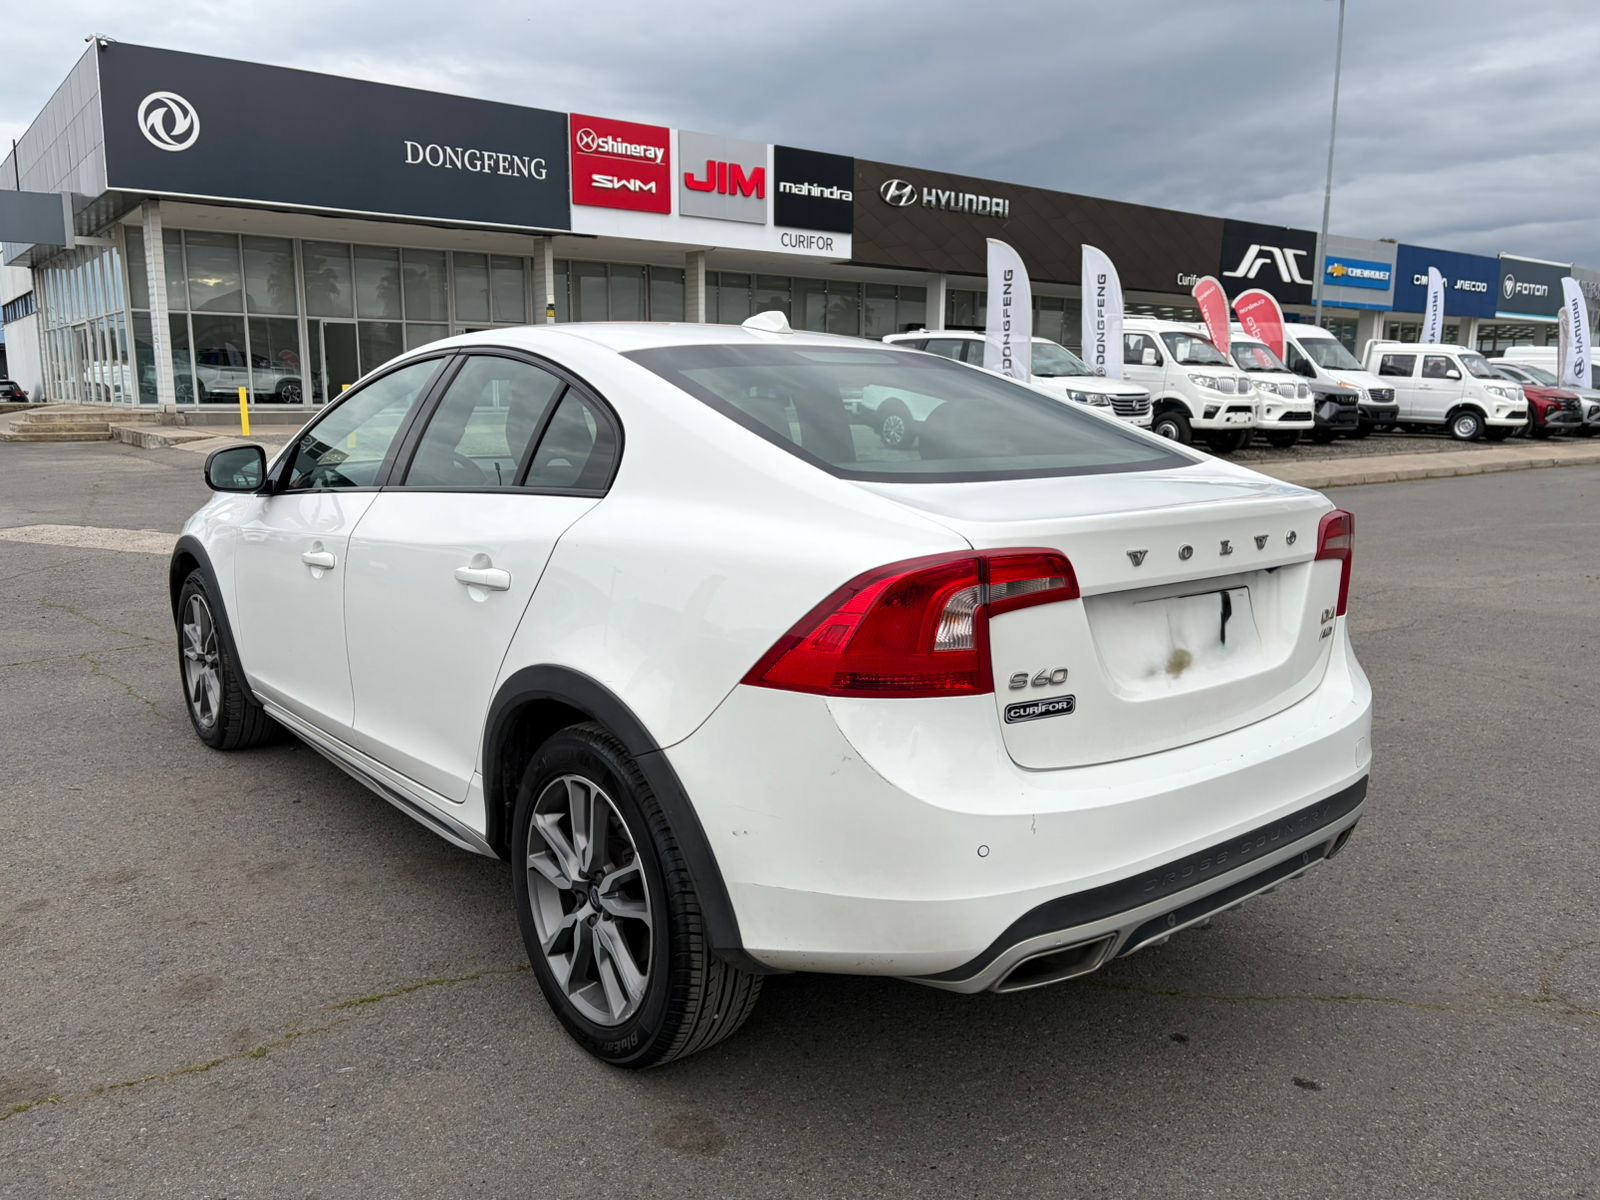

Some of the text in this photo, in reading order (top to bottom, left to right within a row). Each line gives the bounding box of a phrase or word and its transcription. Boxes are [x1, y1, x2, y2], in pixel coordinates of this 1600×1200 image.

[404, 140, 548, 181] DONGFENG
[685, 160, 765, 199] JIM
[591, 174, 656, 194] SWM
[779, 181, 853, 202] mahindra
[921, 186, 1009, 219] HYUNDAI
[781, 232, 834, 252] CURIFOR
[1222, 244, 1313, 285] JAC
[1515, 282, 1549, 296] FOTON
[1002, 269, 1013, 369] DONGFENG
[1096, 274, 1107, 365] DONGFENG
[1126, 529, 1297, 567] VOLVO
[1008, 666, 1068, 691] S60
[1143, 805, 1331, 892] CROSS COUNTRY
